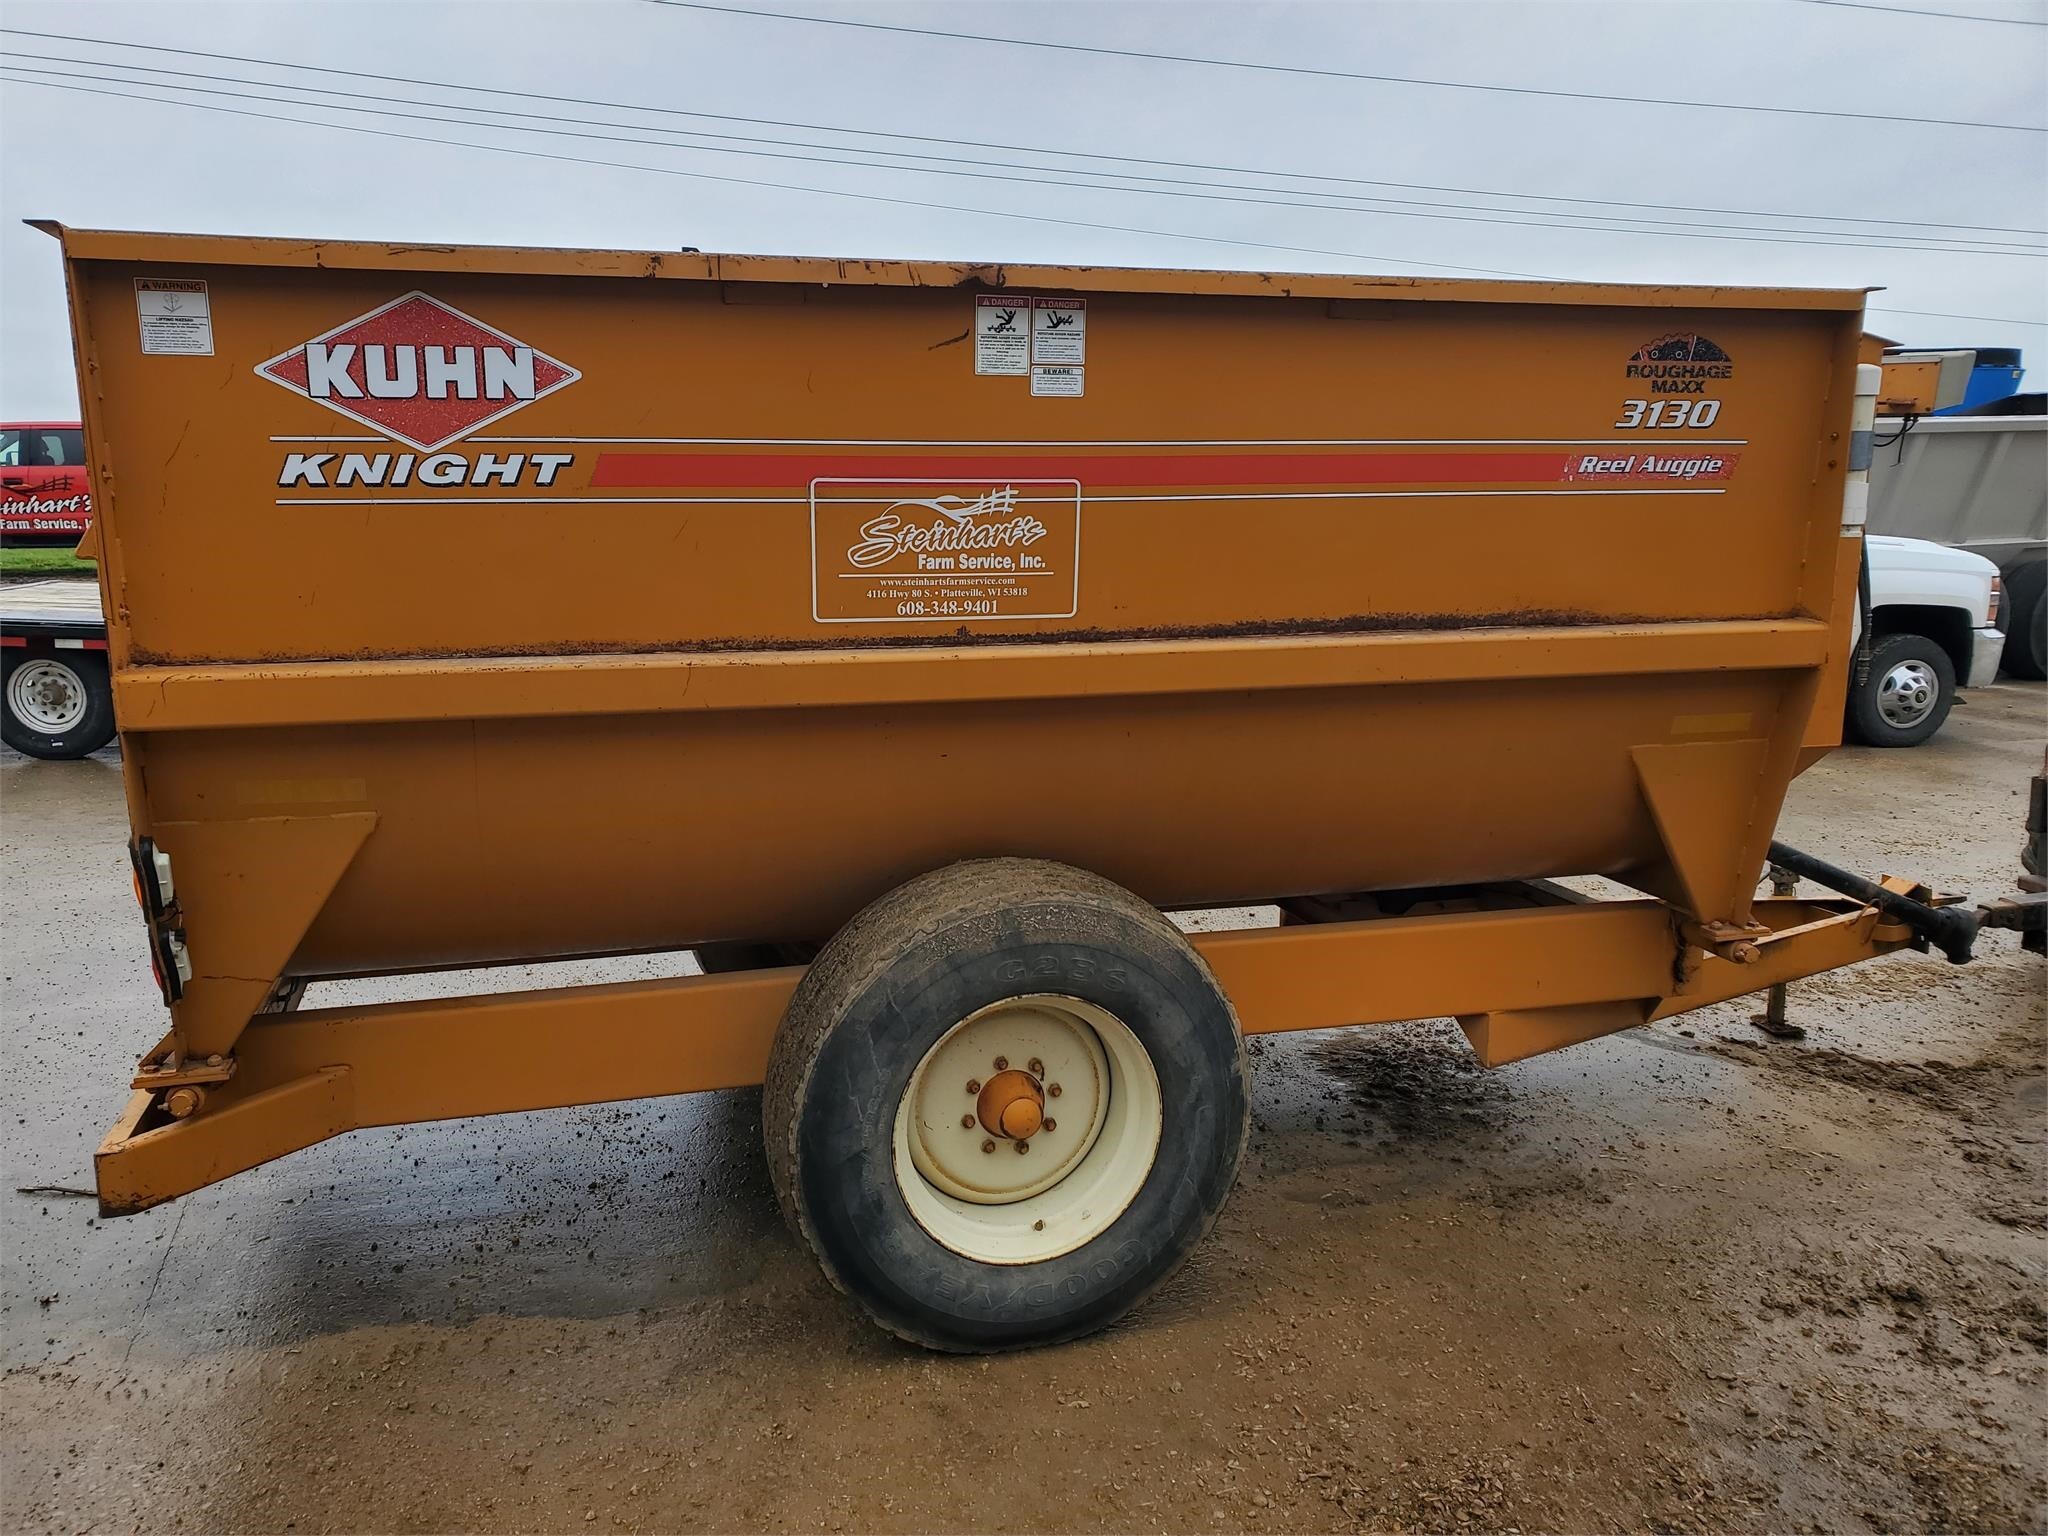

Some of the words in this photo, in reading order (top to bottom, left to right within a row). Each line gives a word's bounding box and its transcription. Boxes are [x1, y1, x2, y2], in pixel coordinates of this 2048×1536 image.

[153, 282, 202, 291] WARNING
[991, 298, 1025, 307] DANGER
[1048, 301, 1080, 309] DANGER
[304, 343, 536, 400] KUHN
[1626, 364, 1733, 379] ROUGHAGE
[1651, 379, 1705, 394] MAXX
[1614, 399, 1722, 429] 3130
[277, 453, 574, 488] KNIGHT
[1578, 455, 1636, 473] Reel
[1638, 455, 1724, 478] Auggie
[0, 519, 30, 530] Farm
[848, 514, 1047, 568] Steinhart's
[918, 553, 955, 570] Farm
[958, 553, 1016, 571] Service,
[1019, 552, 1046, 569] Inc.
[879, 577, 1016, 587] www.steinhartsfarmservice.com
[866, 589, 887, 598] 4116
[889, 589, 909, 600] Hwy
[911, 589, 922, 598] 80
[924, 589, 933, 598] S.
[940, 588, 985, 598] Platteville,
[987, 588, 1001, 597] WI
[1003, 587, 1028, 597] 53818
[897, 599, 998, 616] 608-348-9401
